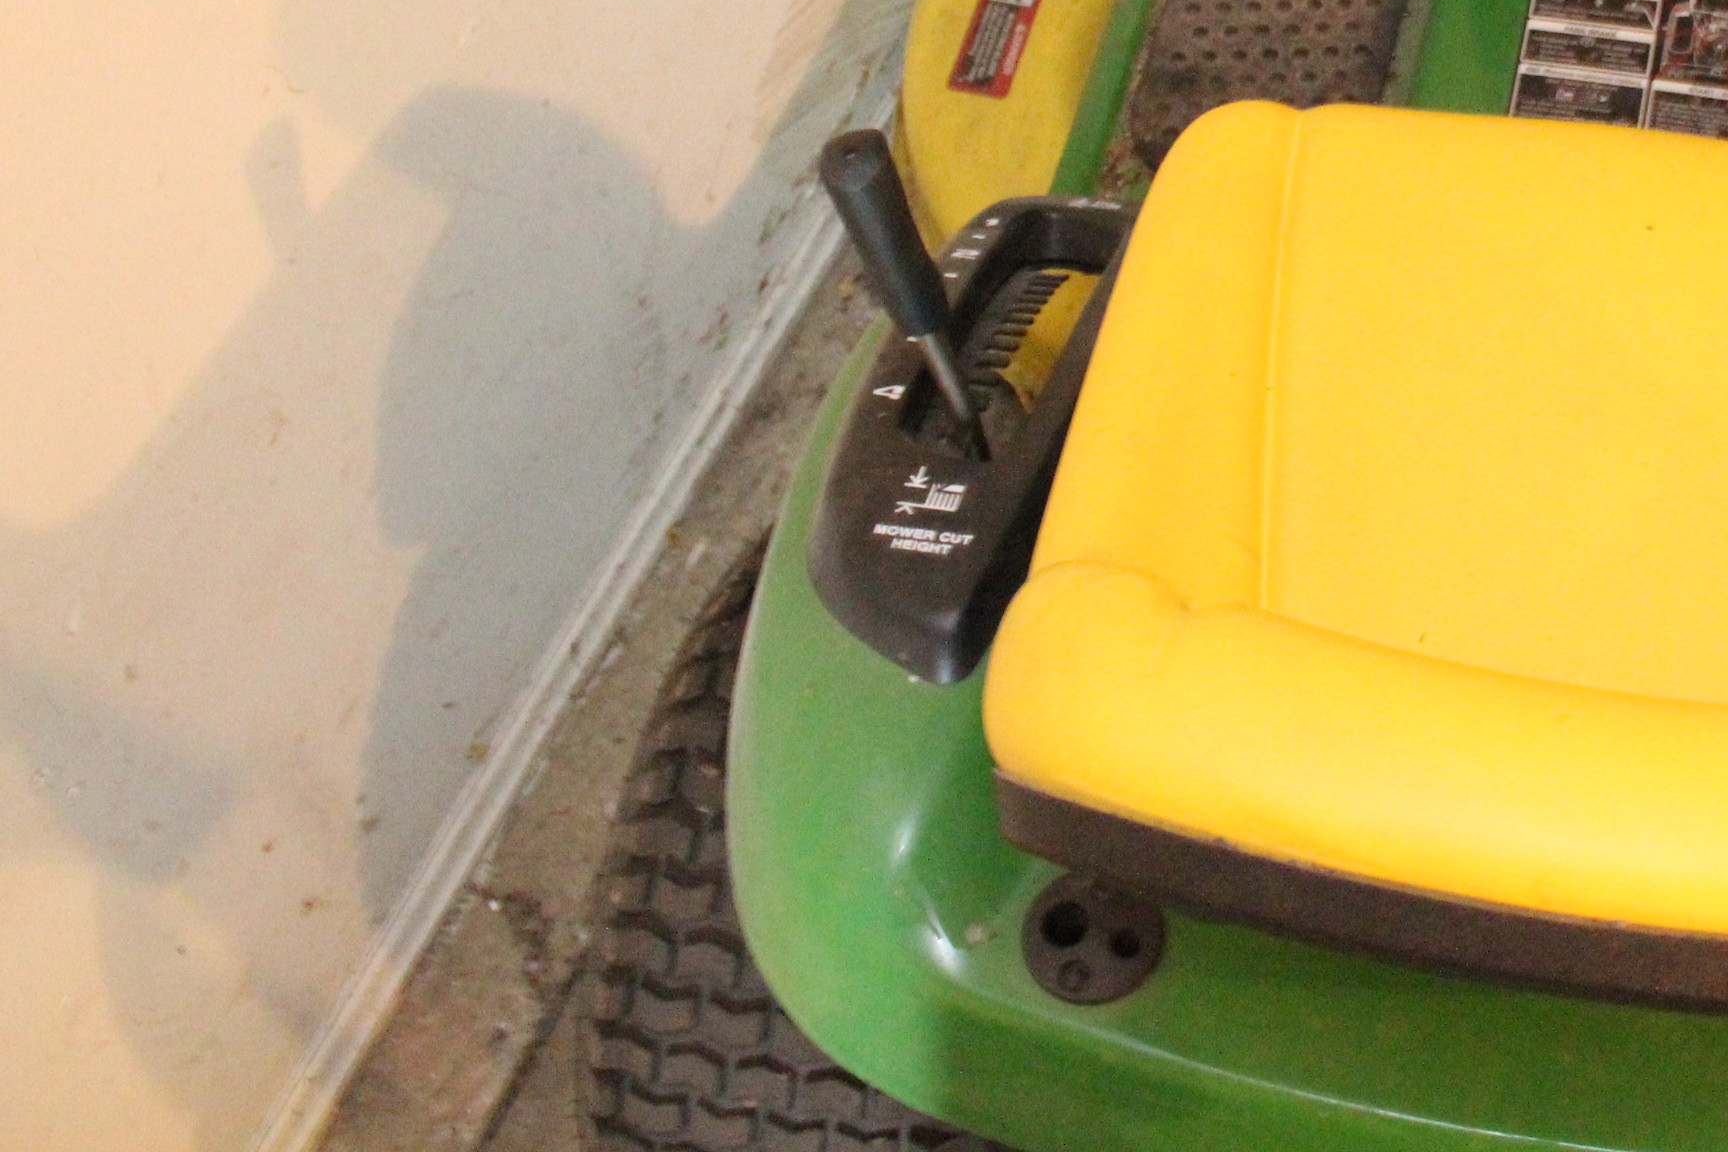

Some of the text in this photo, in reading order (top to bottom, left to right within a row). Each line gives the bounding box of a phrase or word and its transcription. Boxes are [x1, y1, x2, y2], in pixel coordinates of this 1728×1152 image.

[873, 523, 974, 546] MOWER CUT
[890, 536, 953, 556] HEIGHT
